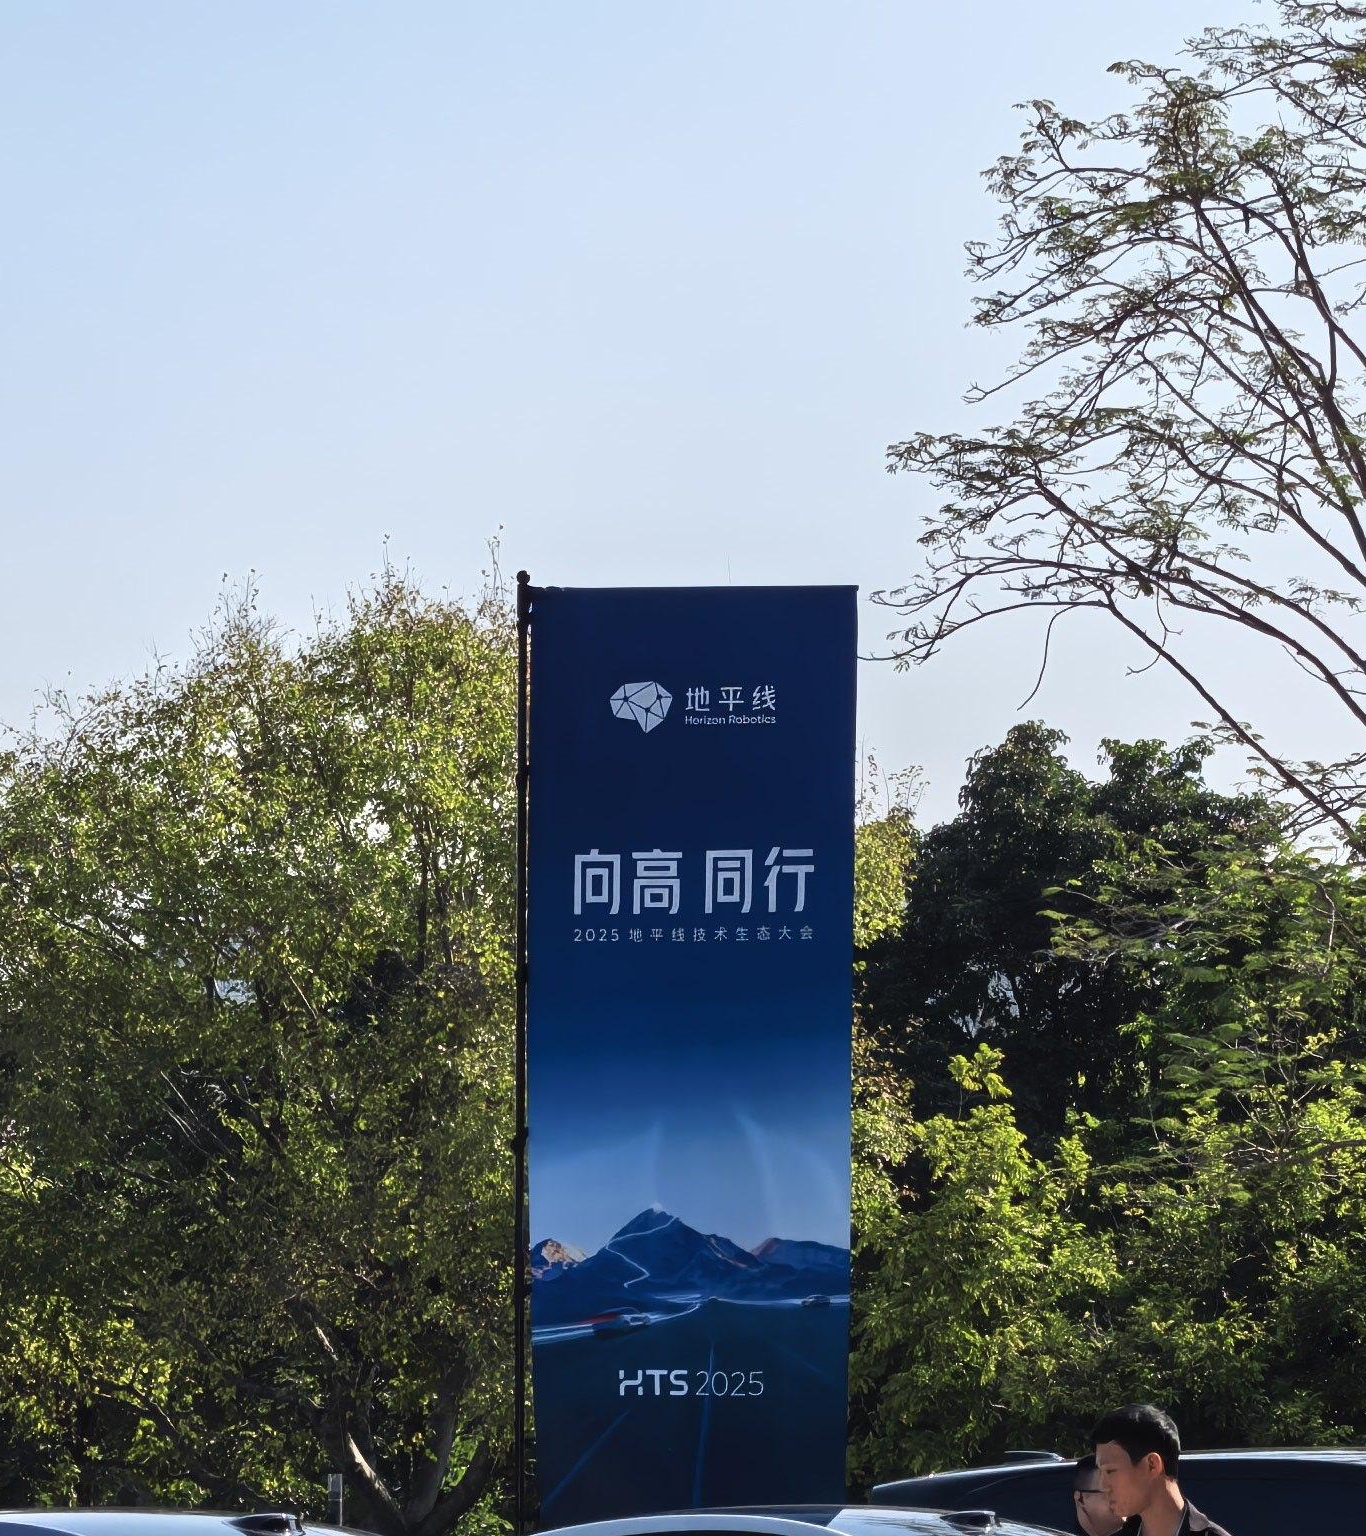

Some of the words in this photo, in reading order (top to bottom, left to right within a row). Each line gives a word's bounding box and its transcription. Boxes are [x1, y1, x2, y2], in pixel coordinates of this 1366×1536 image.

[685, 685, 777, 713] 地平线
[685, 714, 726, 726] Horizon
[729, 714, 777, 725] Robotics
[573, 848, 683, 915] 向高
[704, 847, 815, 914] 同行
[619, 1369, 688, 1397] HTS
[695, 1370, 765, 1397] 2025
